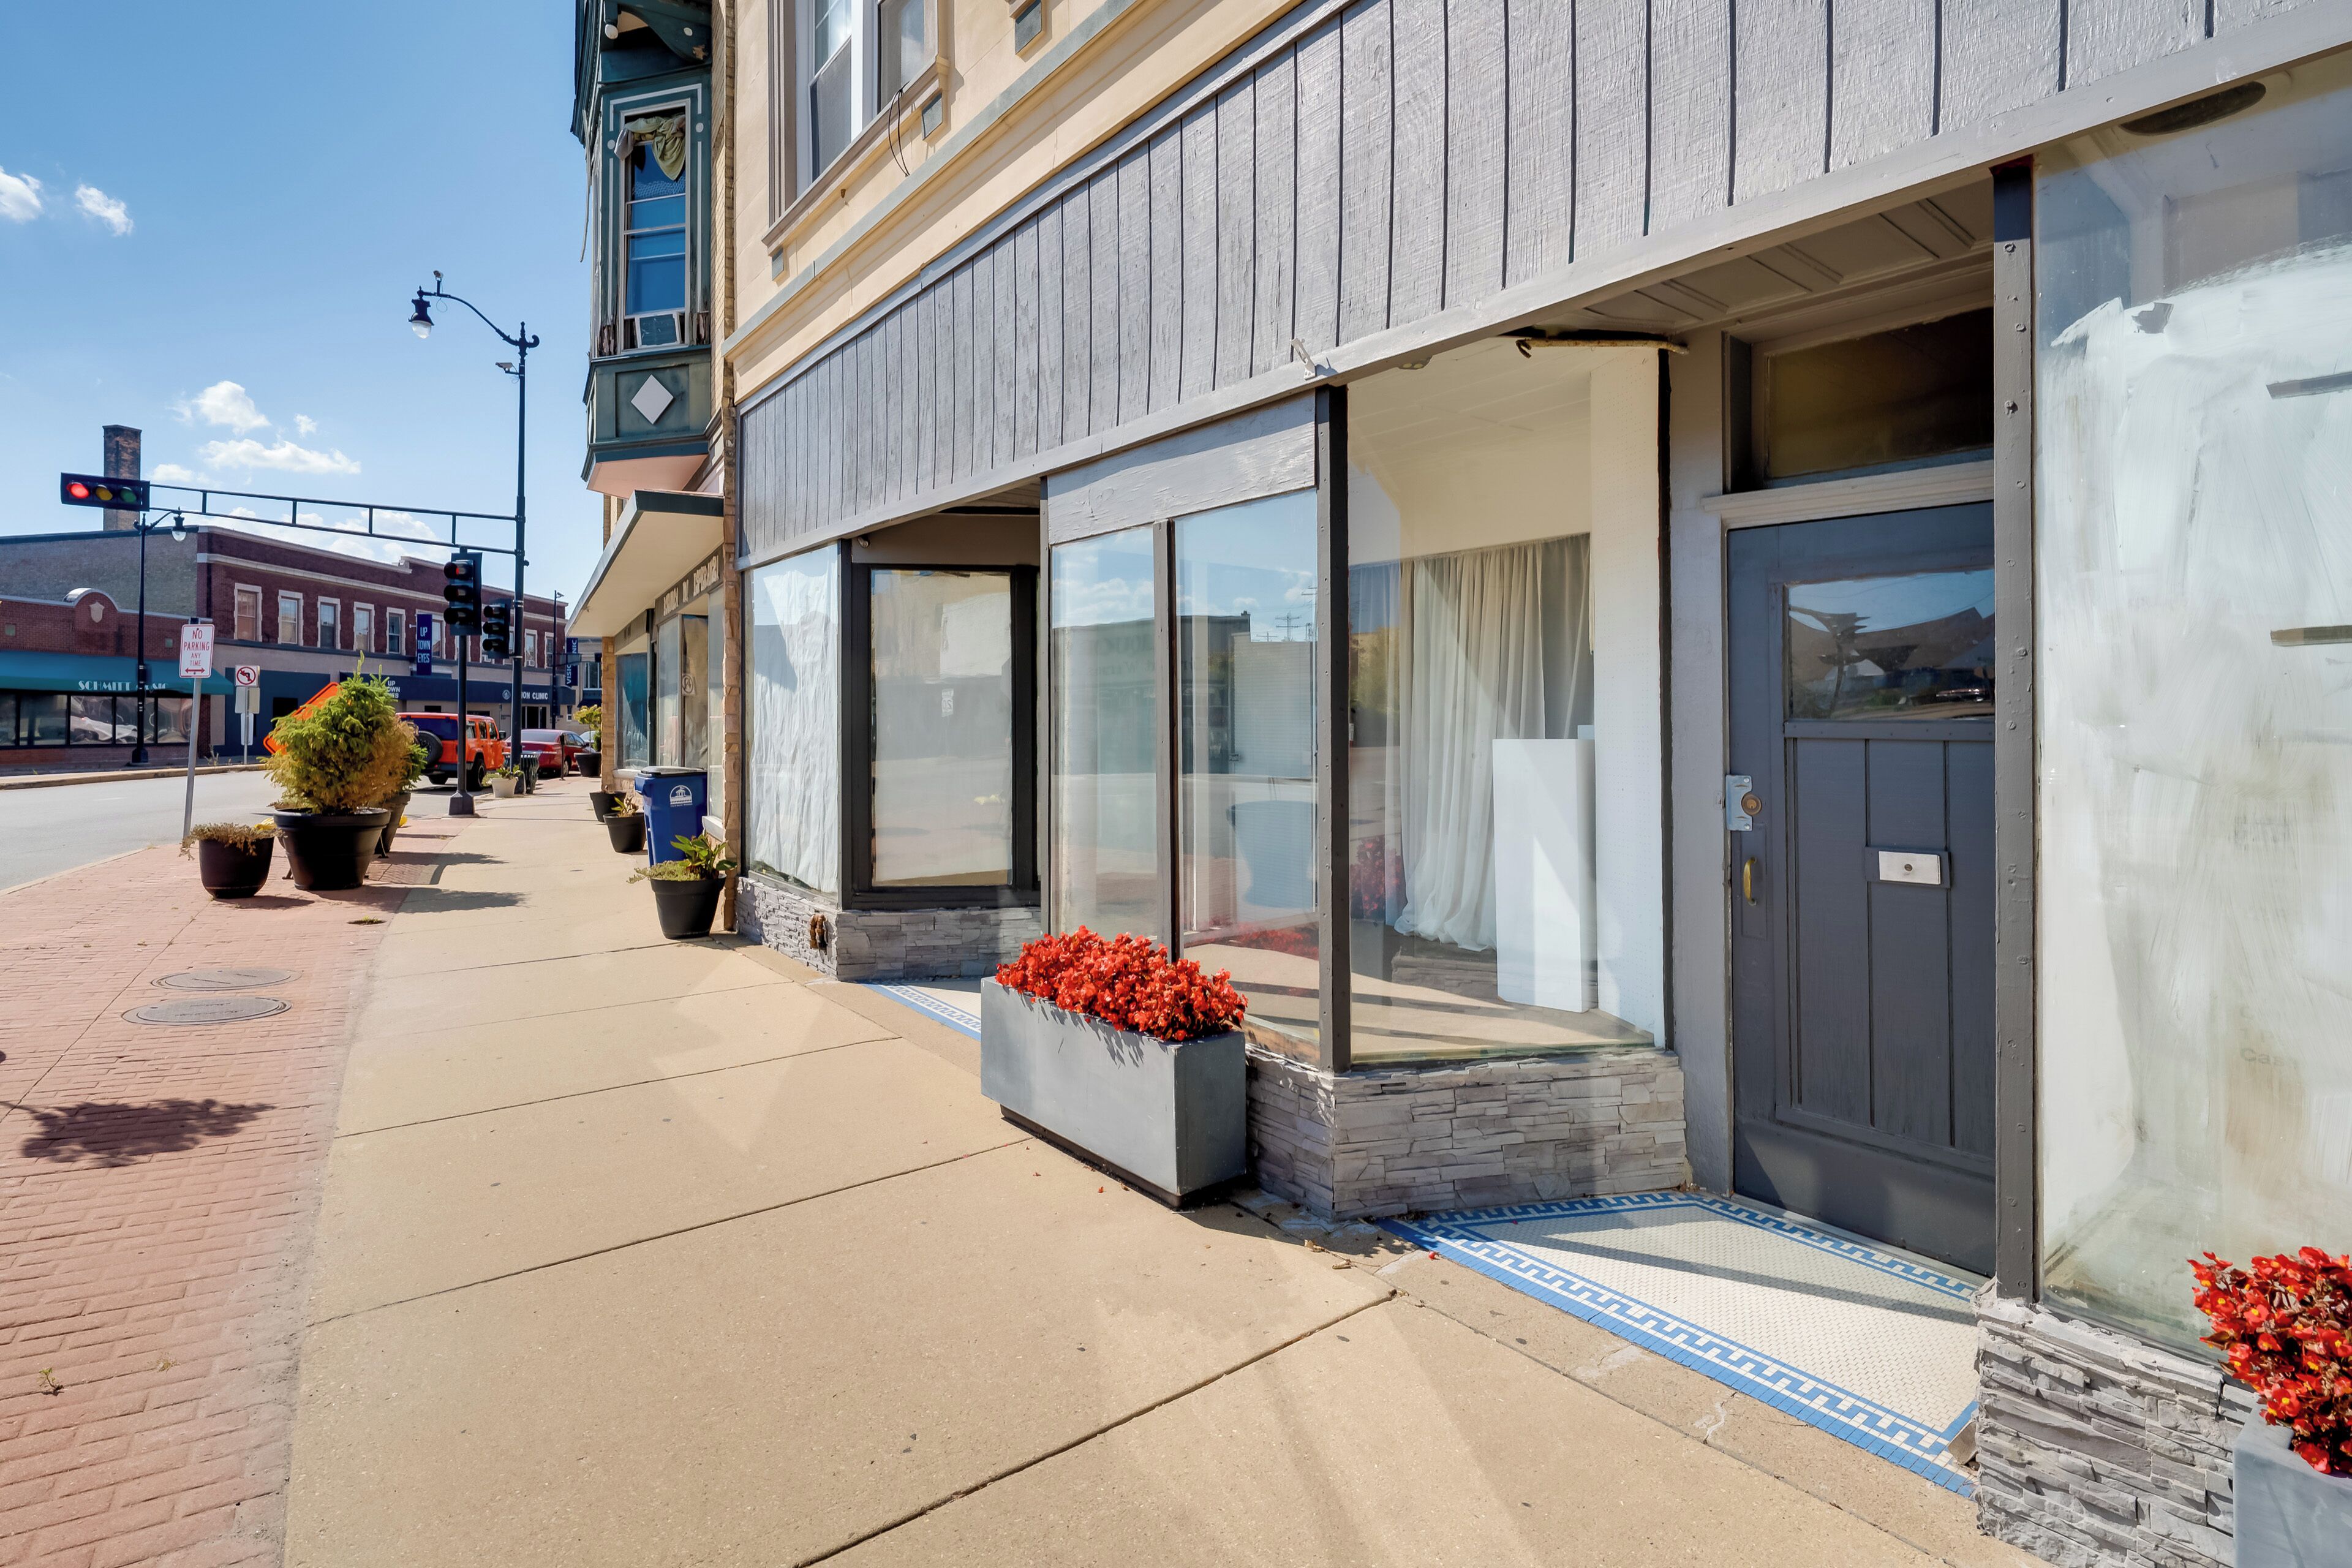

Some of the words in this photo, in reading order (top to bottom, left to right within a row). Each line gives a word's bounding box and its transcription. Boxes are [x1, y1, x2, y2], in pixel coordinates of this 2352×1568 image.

[192, 630, 203, 639] NO
[420, 627, 428, 636] UP
[184, 641, 209, 650] PARKING
[418, 640, 431, 650] TOWN
[418, 653, 429, 663] EYES
[78, 680, 131, 691] SCHMITT
